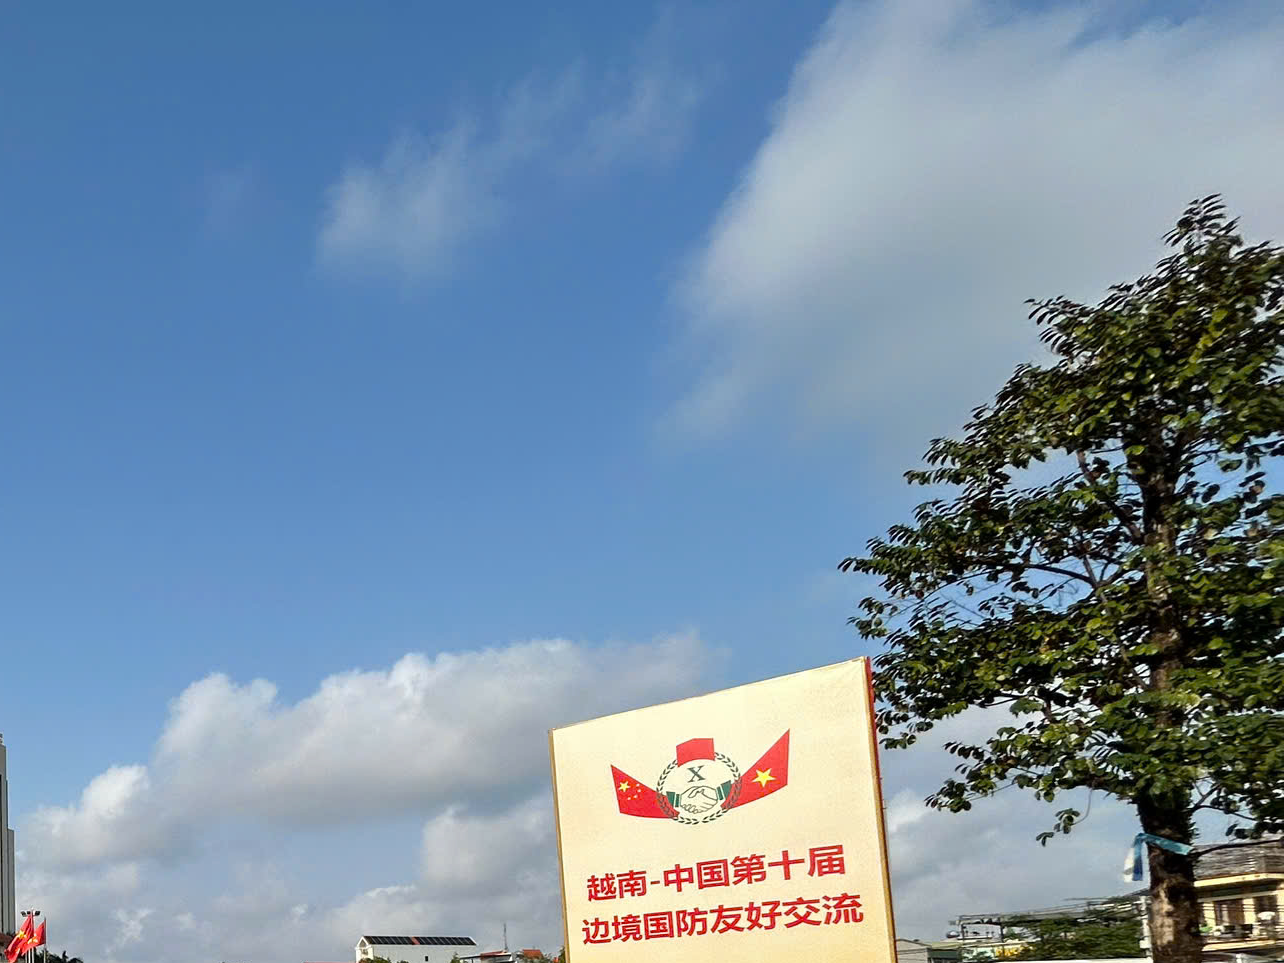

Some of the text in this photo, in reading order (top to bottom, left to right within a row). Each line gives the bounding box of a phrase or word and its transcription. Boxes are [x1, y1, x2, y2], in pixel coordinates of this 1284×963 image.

[687, 765, 705, 783] X
[586, 844, 846, 902] 越南-中国第十届
[582, 892, 864, 945] 边境国防友好交流
